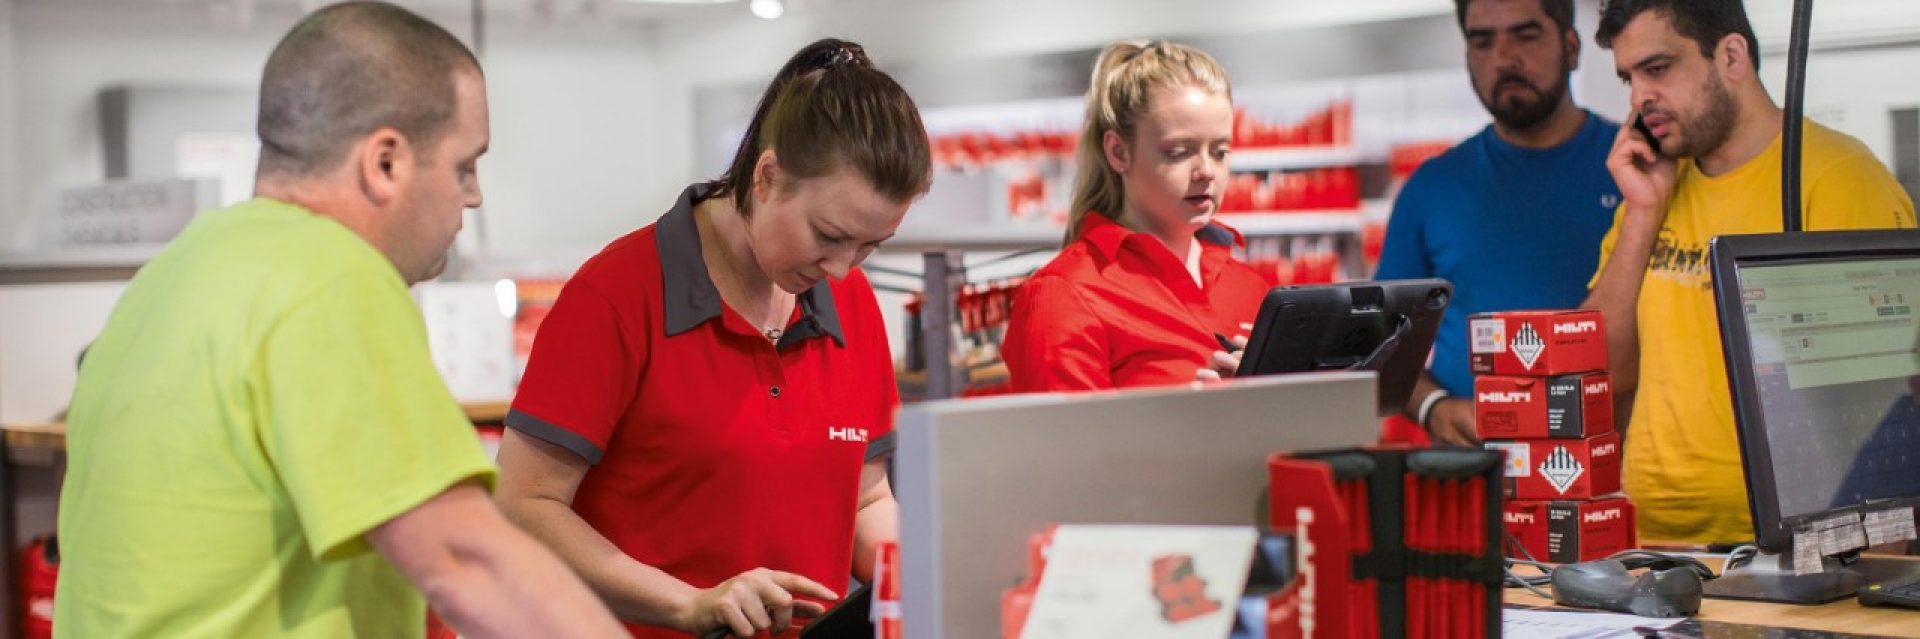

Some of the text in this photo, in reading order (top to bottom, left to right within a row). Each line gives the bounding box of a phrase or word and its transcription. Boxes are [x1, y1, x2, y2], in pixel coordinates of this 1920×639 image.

[1554, 321, 1597, 334] HILTI
[1585, 382, 1609, 396] HILTI
[1479, 392, 1531, 402] HILTI
[829, 426, 868, 442] HILT
[1592, 444, 1615, 457] HILTI
[1503, 512, 1534, 524] ILTI
[1584, 508, 1621, 523] HILTI
